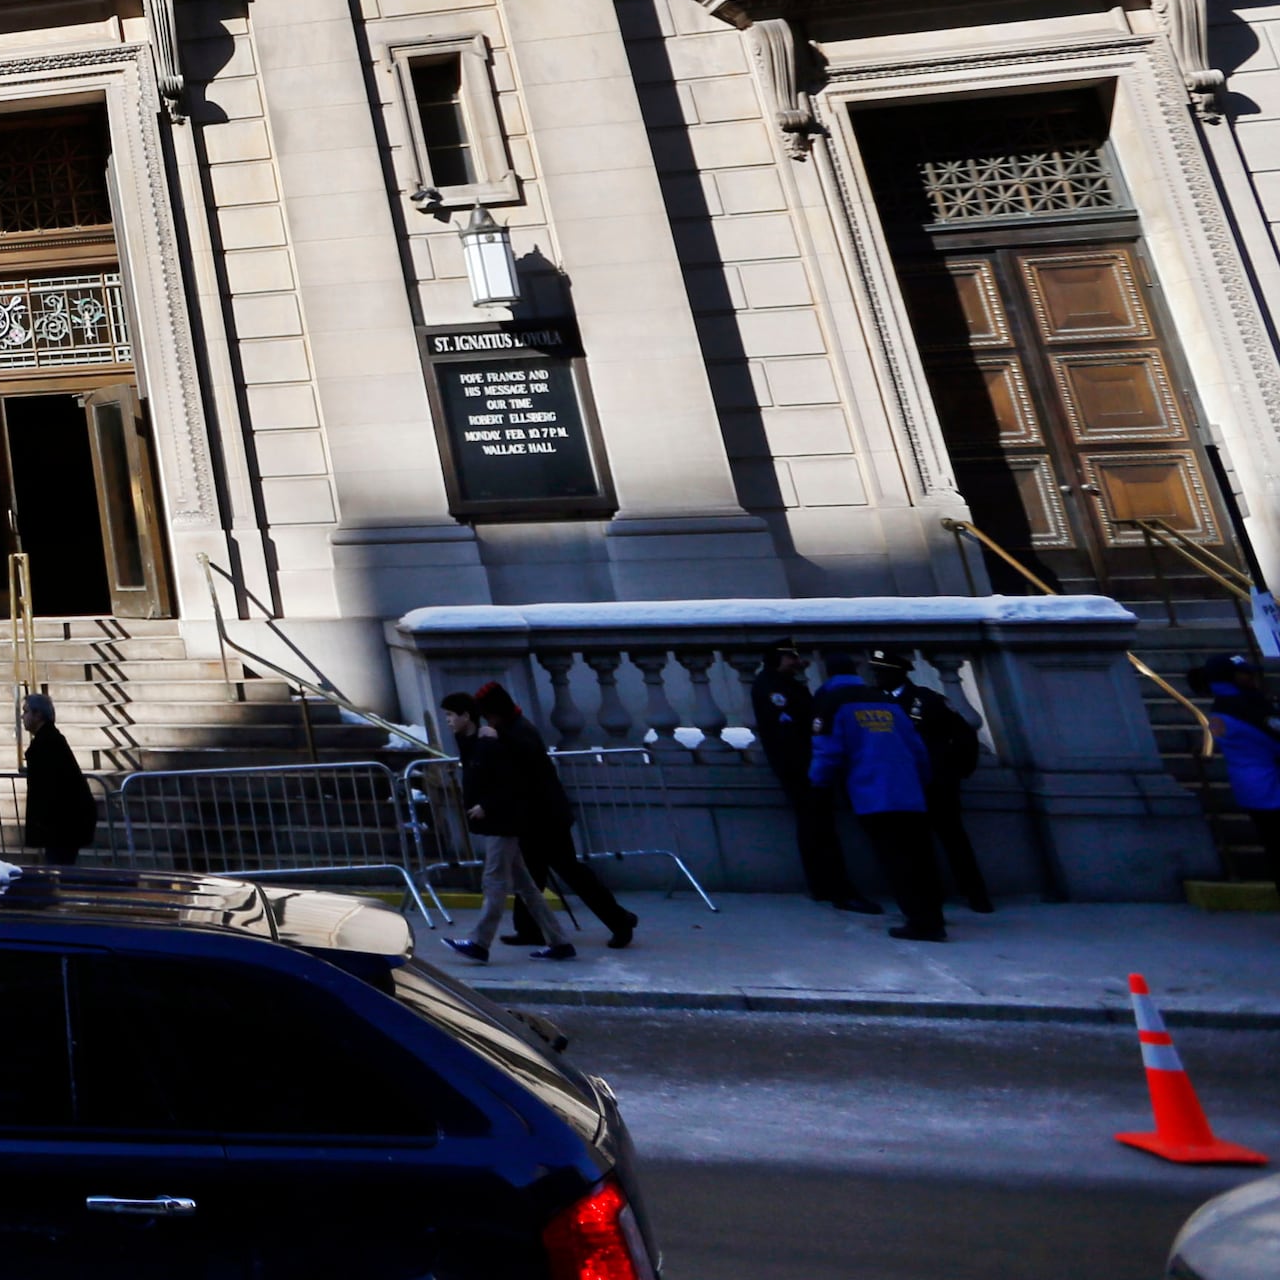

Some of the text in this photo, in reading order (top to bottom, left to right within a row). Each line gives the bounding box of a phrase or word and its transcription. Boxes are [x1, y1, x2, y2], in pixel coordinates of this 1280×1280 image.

[434, 330, 562, 352] ST. IGNATIUS LOYOLA
[460, 370, 549, 384] POPE FRANCIS AND
[464, 383, 549, 397] HIS MESSAGE FOR
[486, 398, 533, 410] OUR TIME
[468, 412, 557, 425] ROBERT ELLSBERG
[482, 444, 527, 455] WALLACE
